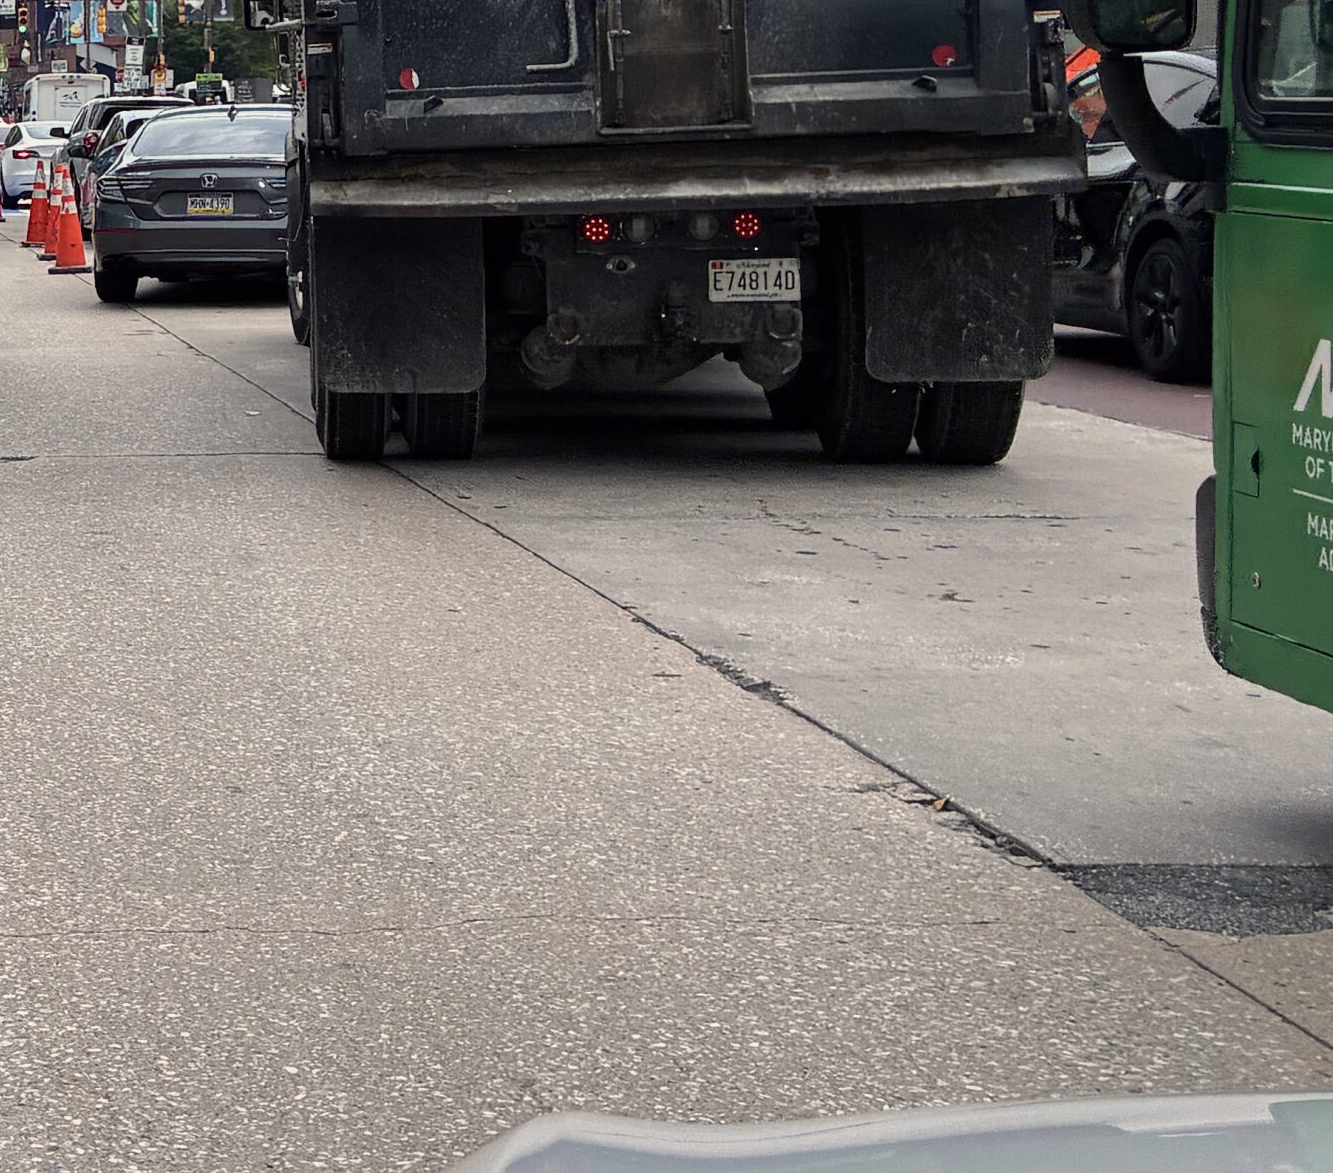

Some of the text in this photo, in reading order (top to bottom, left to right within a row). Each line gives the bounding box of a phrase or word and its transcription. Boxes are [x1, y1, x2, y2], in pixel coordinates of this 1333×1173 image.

[713, 270, 795, 291] E74814D
[1292, 422, 1333, 455] MARY
[1304, 455, 1326, 479] OF
